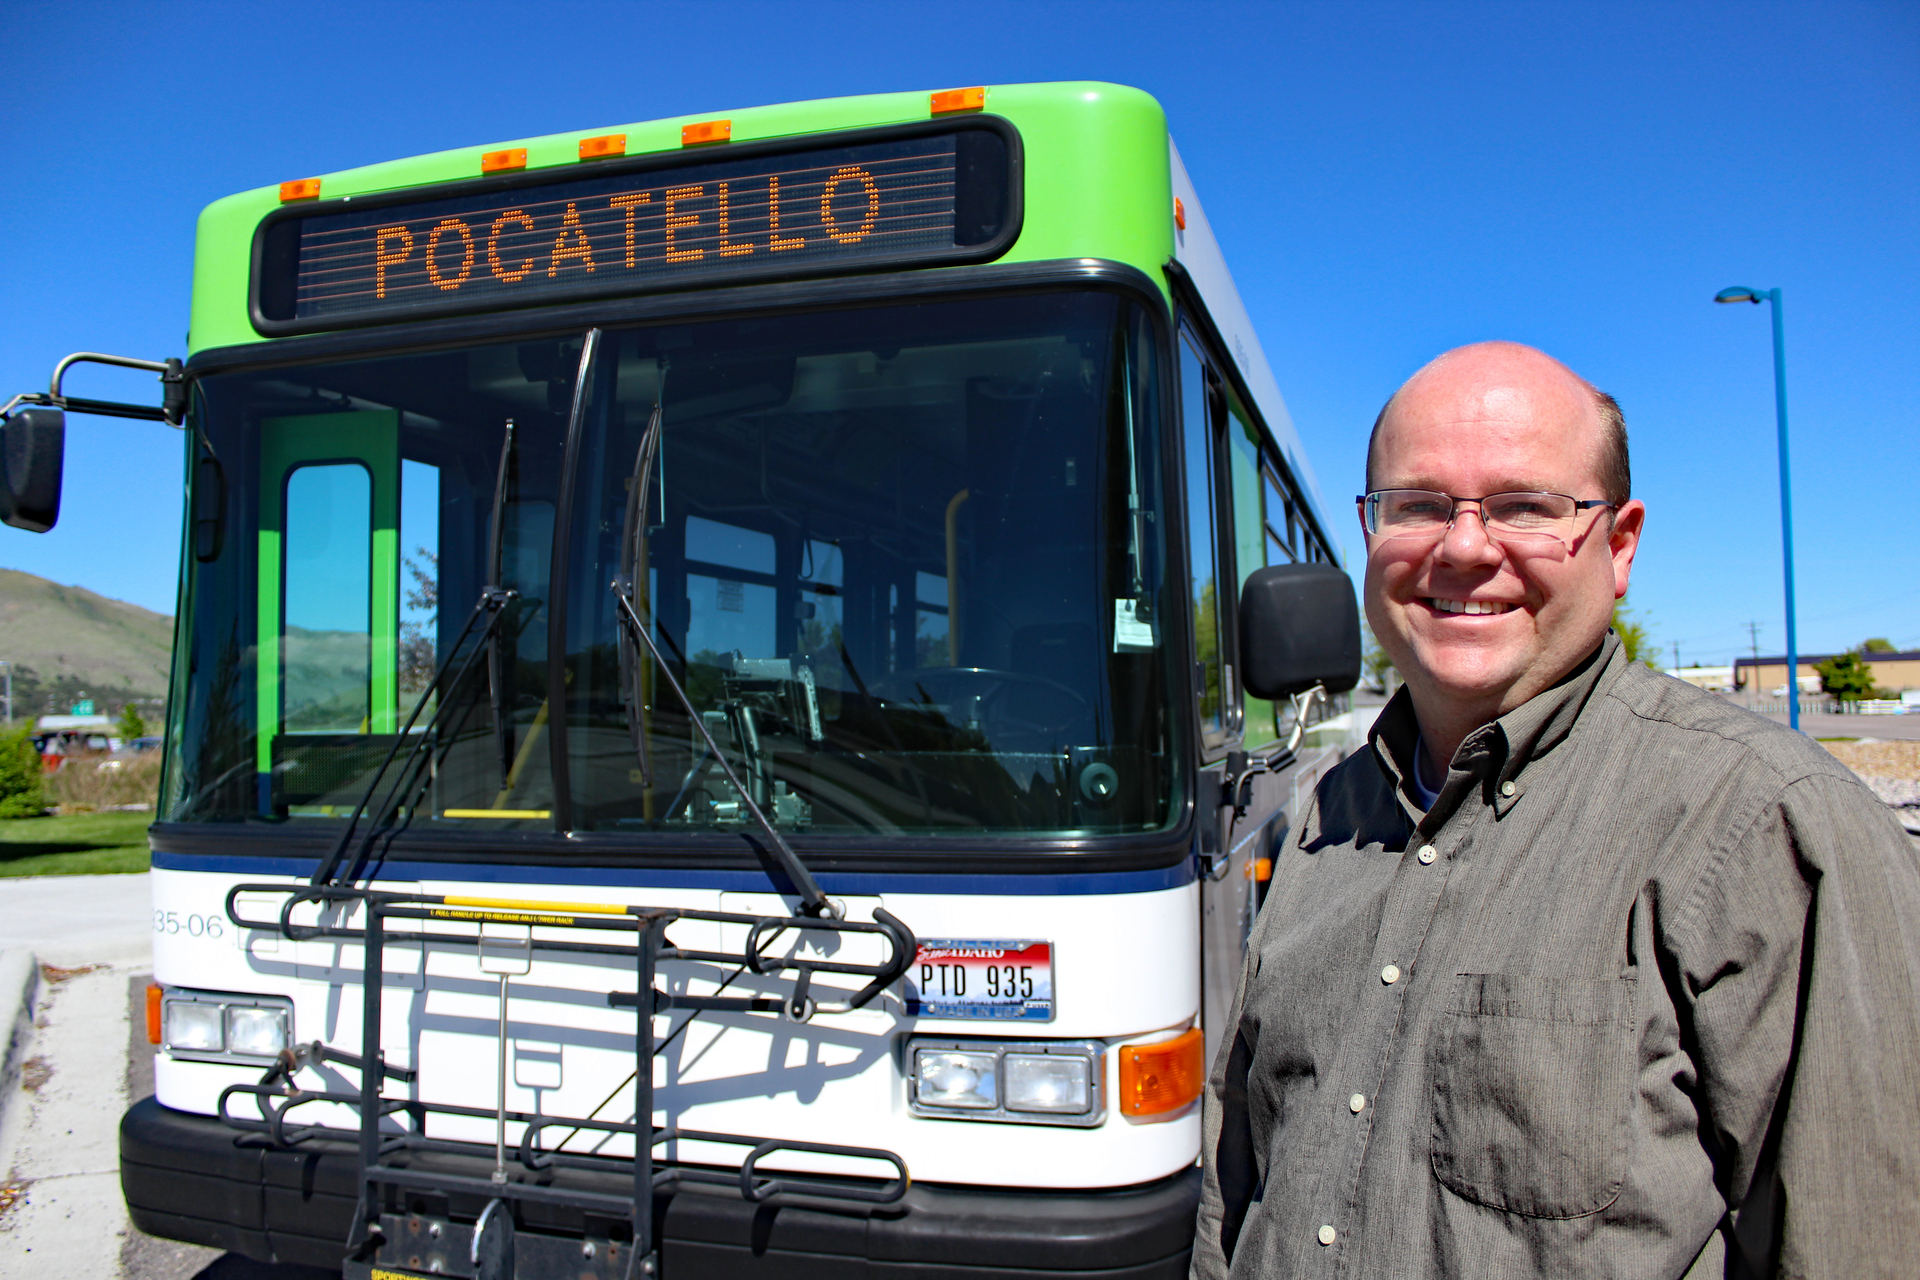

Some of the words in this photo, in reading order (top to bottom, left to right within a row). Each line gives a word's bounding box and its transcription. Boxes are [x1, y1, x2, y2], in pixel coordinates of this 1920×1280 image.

[375, 165, 880, 299] POCATELLO
[152, 908, 223, 938] 35-06
[435, 909, 450, 918] PULL
[474, 911, 483, 919] UP
[484, 912, 492, 920] TO
[492, 912, 520, 922] RELEASE
[556, 916, 574, 925] RACK
[951, 949, 1005, 958] IDAHO
[921, 964, 966, 996] PTD
[987, 965, 1033, 998] 935
[935, 1007, 973, 1017] MADE
[977, 1008, 990, 1017] IN
[994, 1008, 1020, 1018] USA
